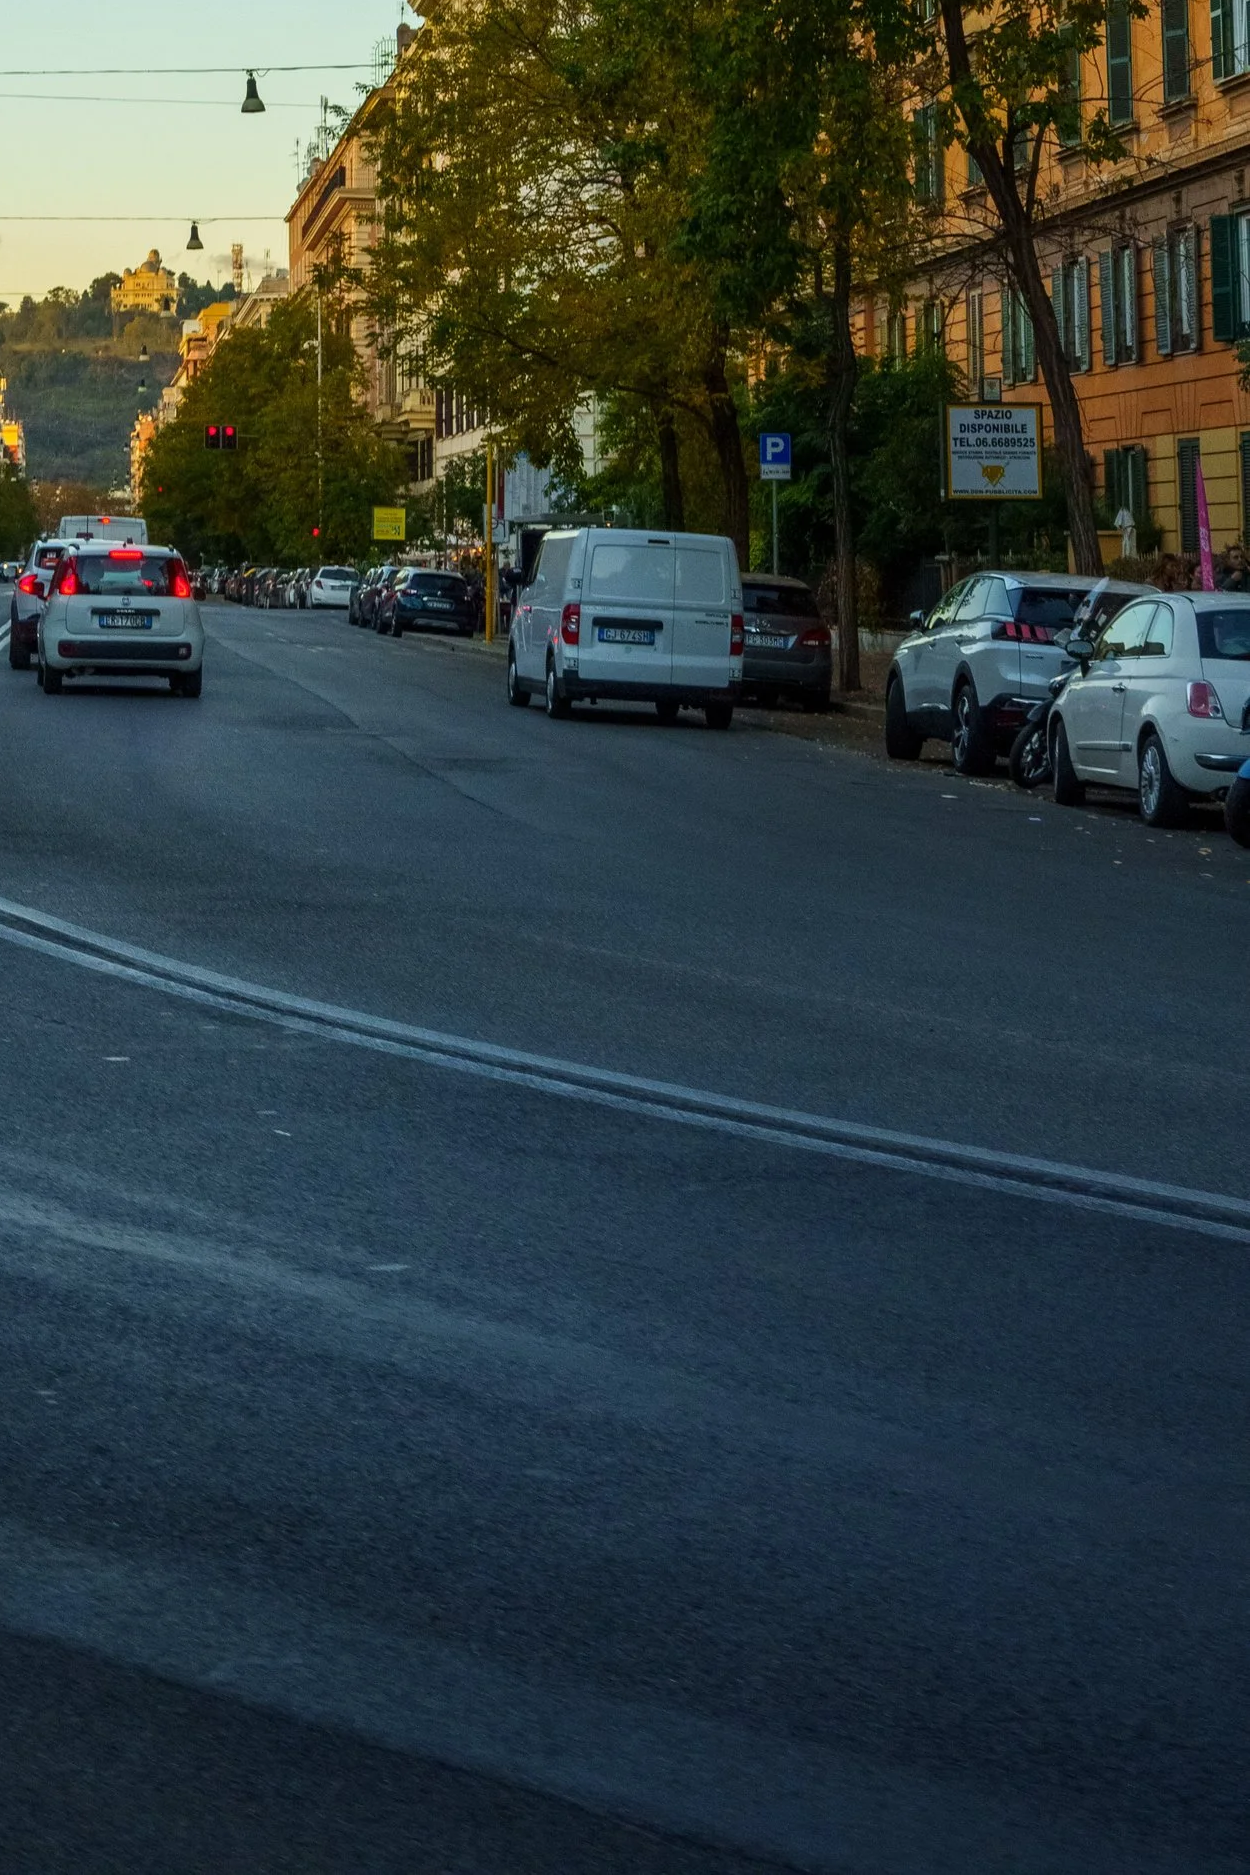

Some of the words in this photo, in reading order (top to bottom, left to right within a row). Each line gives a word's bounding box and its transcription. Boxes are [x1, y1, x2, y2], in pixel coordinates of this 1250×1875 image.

[974, 410, 1012, 420] SPAZIO
[959, 423, 1027, 434] DISPONIBILE
[953, 438, 1035, 447] TEL.06.6689525
[766, 436, 785, 461] P
